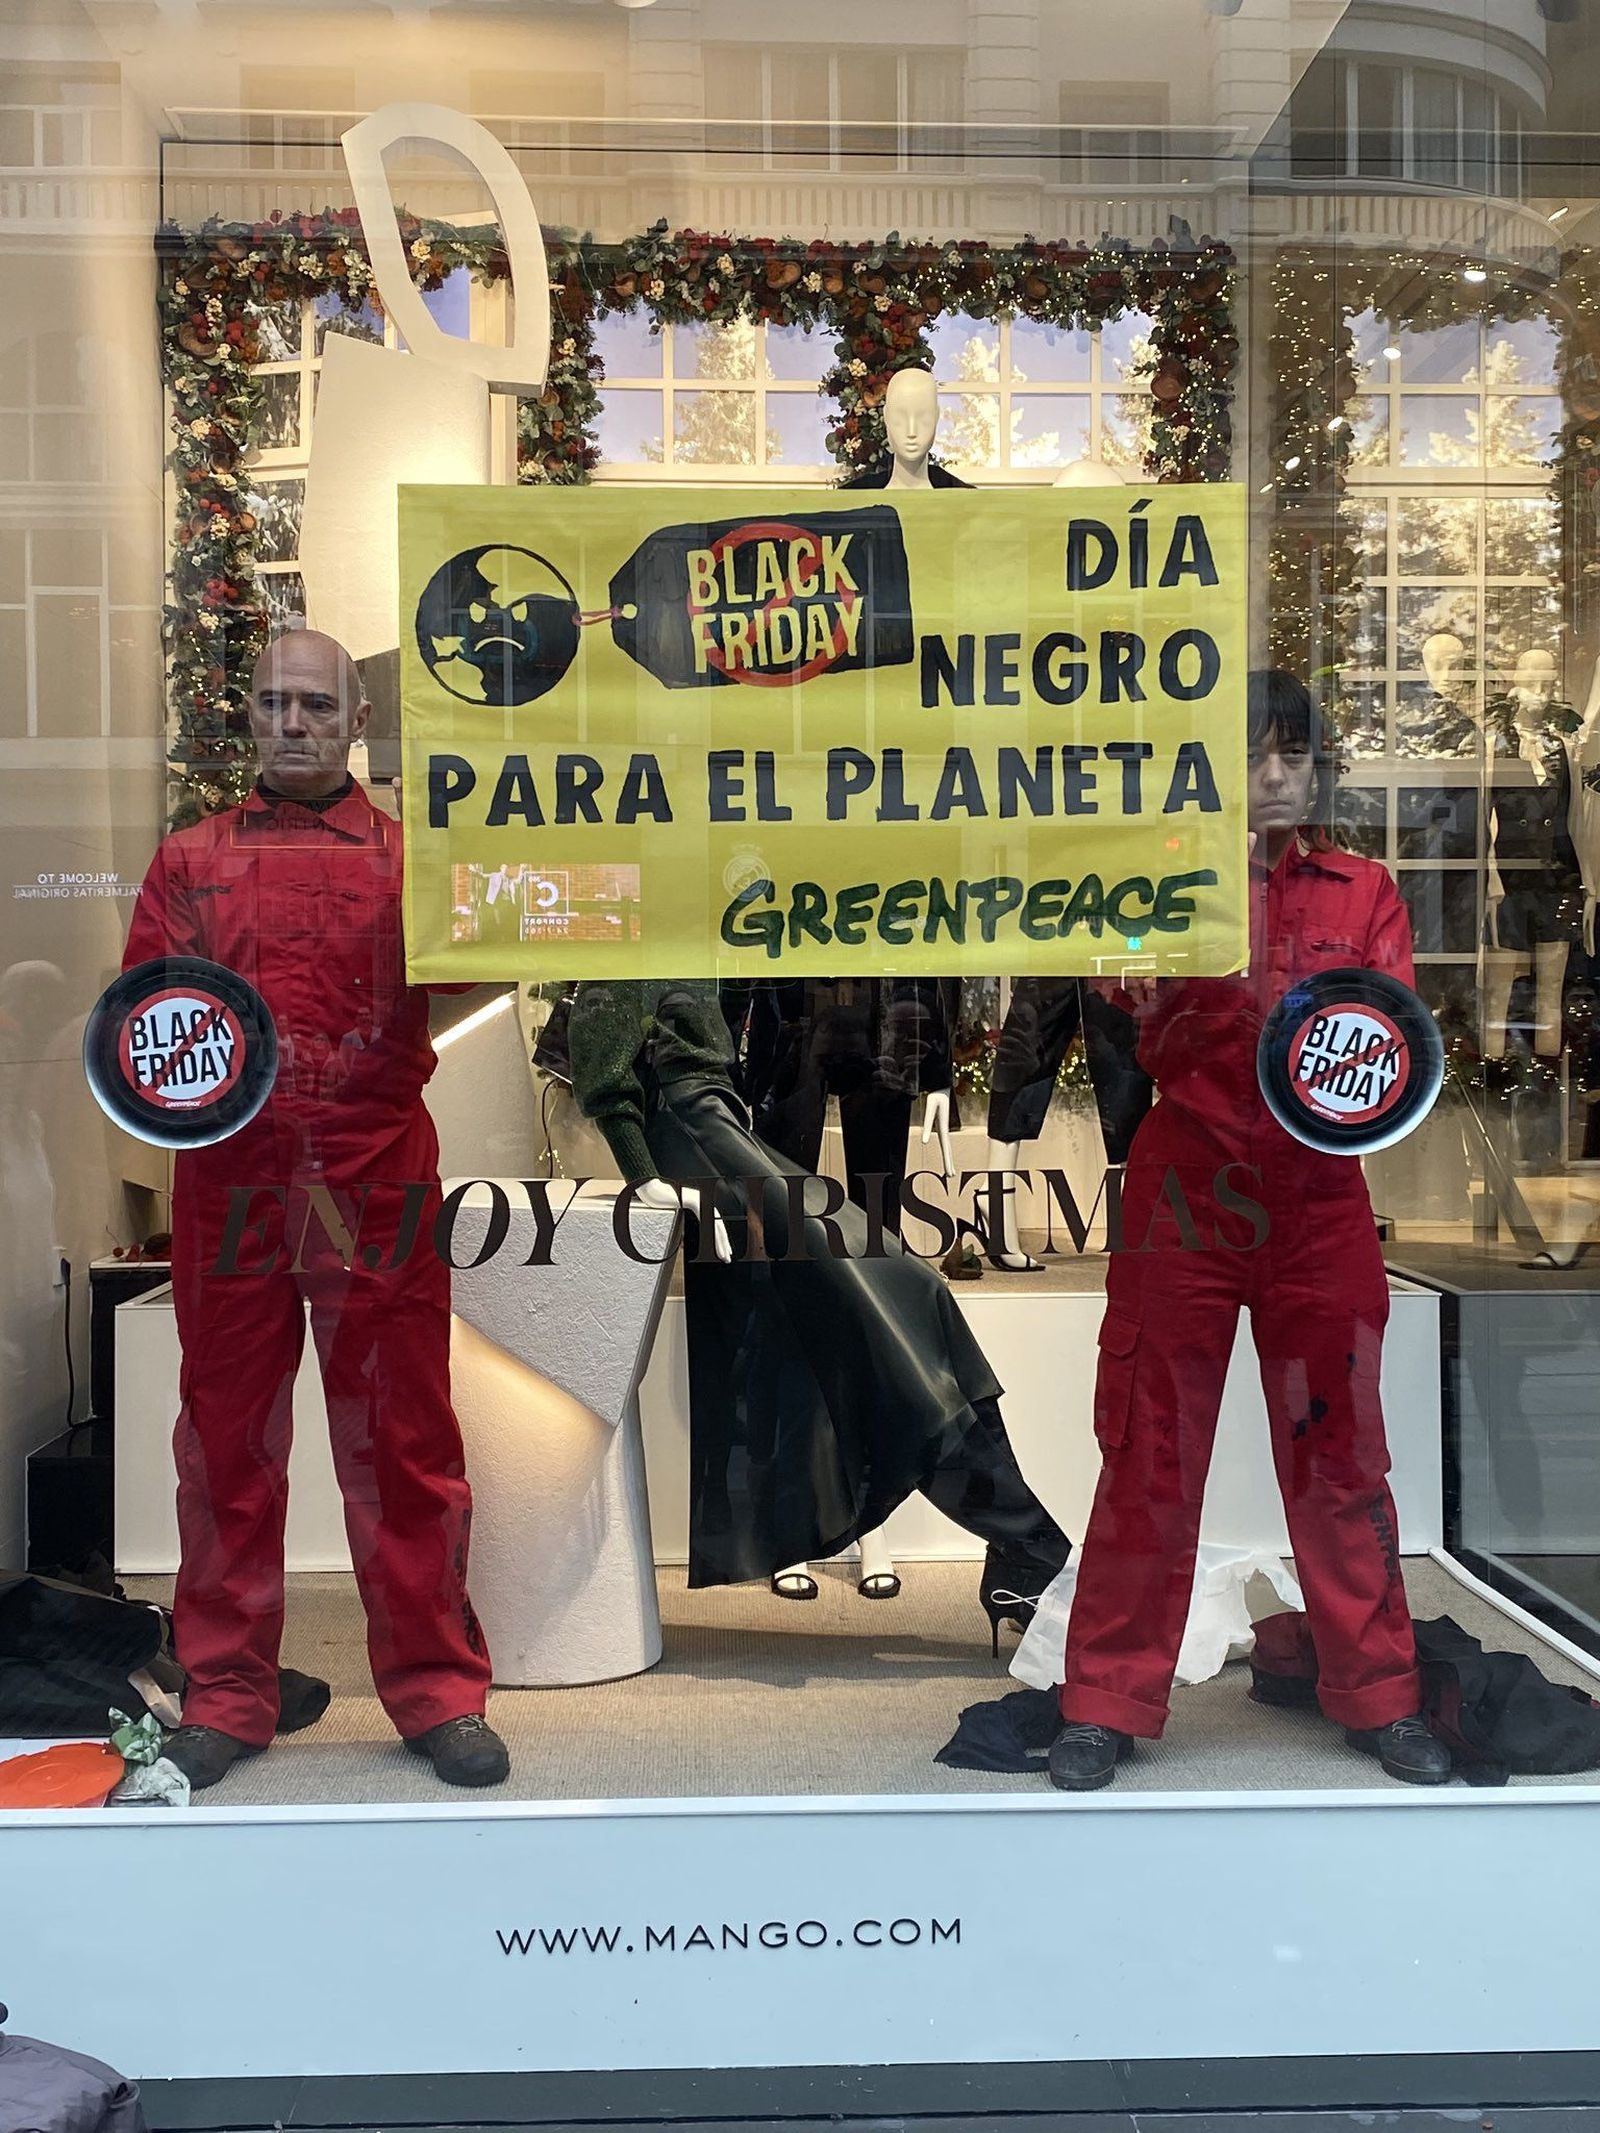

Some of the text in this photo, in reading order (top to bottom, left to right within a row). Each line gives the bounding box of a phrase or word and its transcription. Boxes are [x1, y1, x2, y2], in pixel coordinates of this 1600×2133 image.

[686, 532, 859, 608] BLACK
[1066, 498, 1219, 591] DÍA
[692, 596, 864, 674] FRIDAY
[921, 628, 1221, 708] NEGRO
[428, 741, 1222, 828] PARA EL PLANETA
[720, 868, 1218, 959] GREENPEACE
[129, 1006, 231, 1051] BLACK
[131, 1044, 235, 1090] FRIDAY
[1305, 1013, 1406, 1074] BLACK
[1293, 1050, 1397, 1110] FRIDAY
[207, 1162, 1271, 1274] ENJOY CHRISTMAS
[495, 1917, 961, 1955] WWW.MANGO.COM
